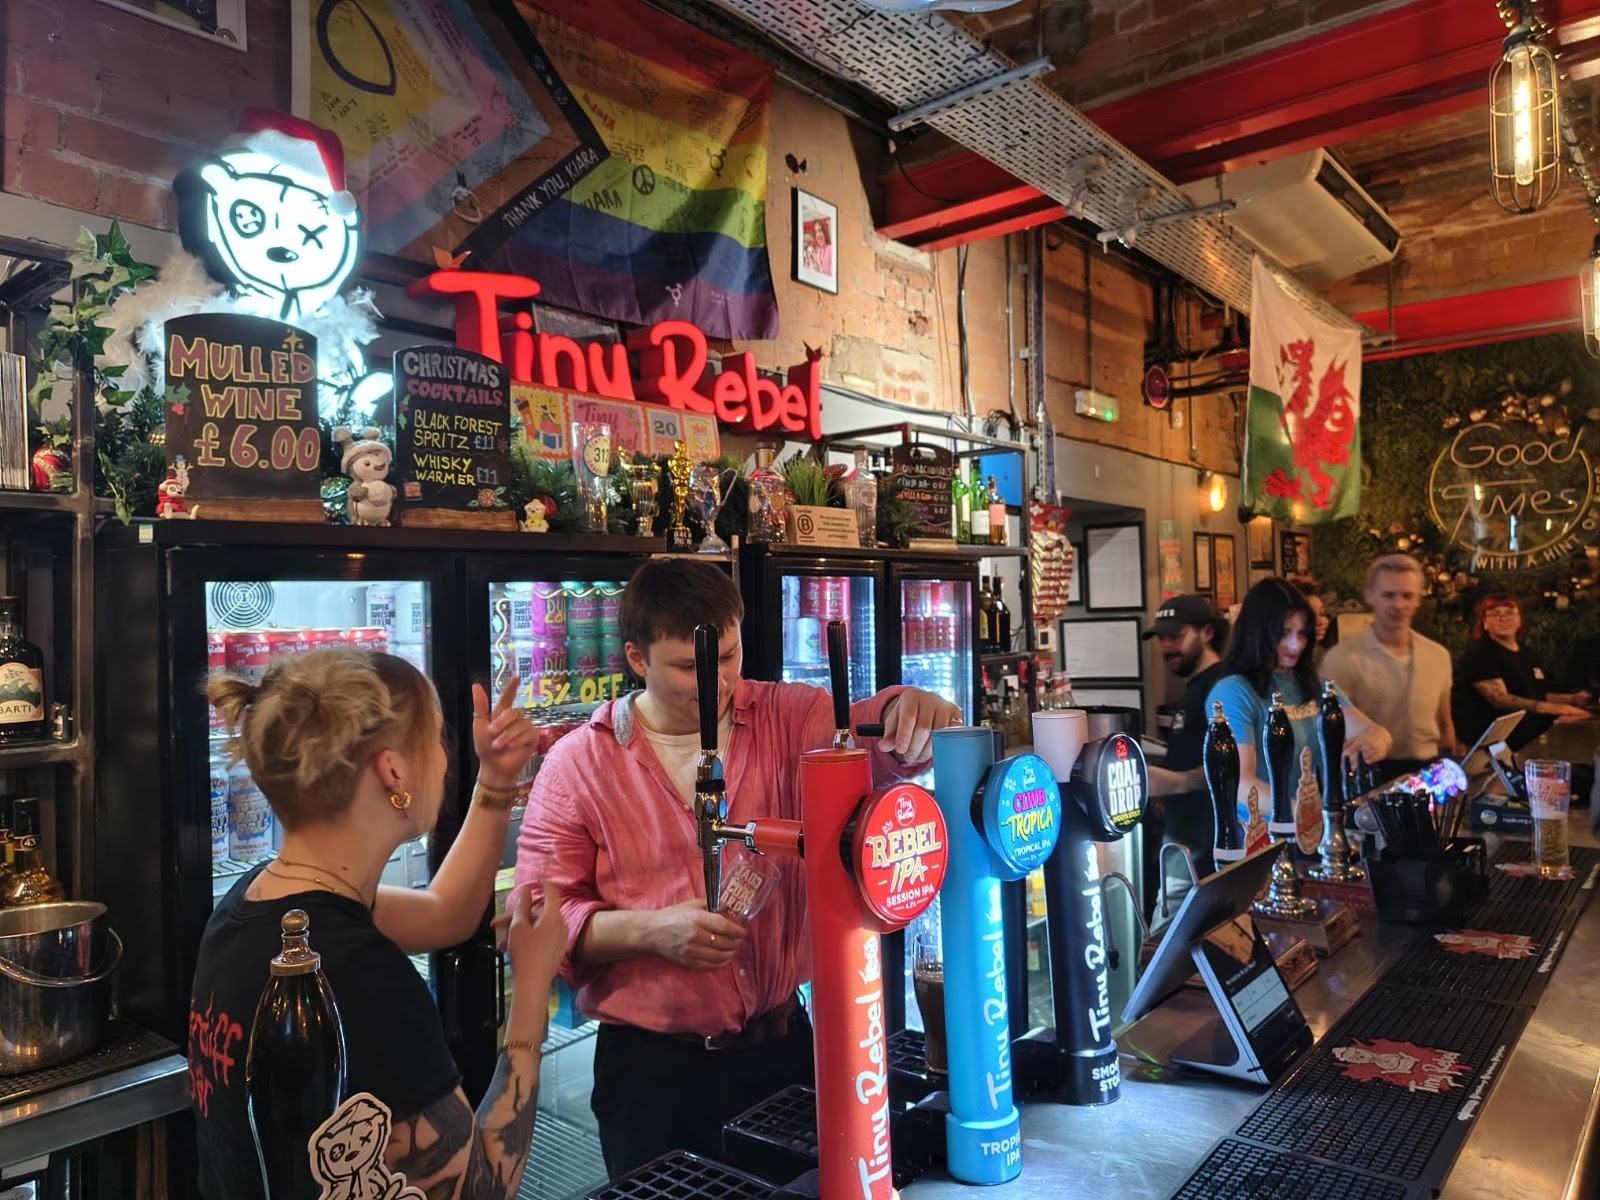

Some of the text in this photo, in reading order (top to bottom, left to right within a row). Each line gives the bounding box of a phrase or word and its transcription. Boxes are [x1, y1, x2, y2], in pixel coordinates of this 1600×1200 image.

[501, 194, 543, 228] THANK
[538, 173, 569, 198] YOU,
[565, 148, 599, 178] KIARA
[169, 334, 317, 384] MULLED
[402, 351, 500, 388] CHRISTMAS
[407, 379, 503, 407] COCKTAILS
[650, 320, 822, 440] Rebel
[201, 384, 302, 421] WINE
[413, 430, 494, 450] SPRITZ £11
[414, 409, 502, 436] BLACK FOREST
[654, 420, 678, 436] 20
[193, 422, 321, 471] £6.00
[413, 453, 472, 473] WHISKY
[1451, 422, 1585, 469] Good
[415, 469, 476, 486] WARMER
[1477, 556, 1517, 569] WITH
[1527, 555, 1538, 568] A
[1543, 534, 1580, 562] HINT
[523, 673, 624, 708] 15% OFF
[1107, 759, 1140, 788] COAL
[897, 797, 912, 810] Tiny
[1012, 788, 1046, 813] CLWB
[1109, 785, 1141, 816] DROP
[1002, 806, 1054, 844] TROPICA
[865, 821, 942, 869] REBEL
[1014, 840, 1051, 858] TROPICAL IPA
[890, 856, 928, 893] IPA
[886, 884, 935, 908] SESSION IPA
[1082, 887, 1106, 970] Rebel
[982, 930, 1008, 1027] Rebel
[854, 989, 892, 1200] Tiny Rebel
